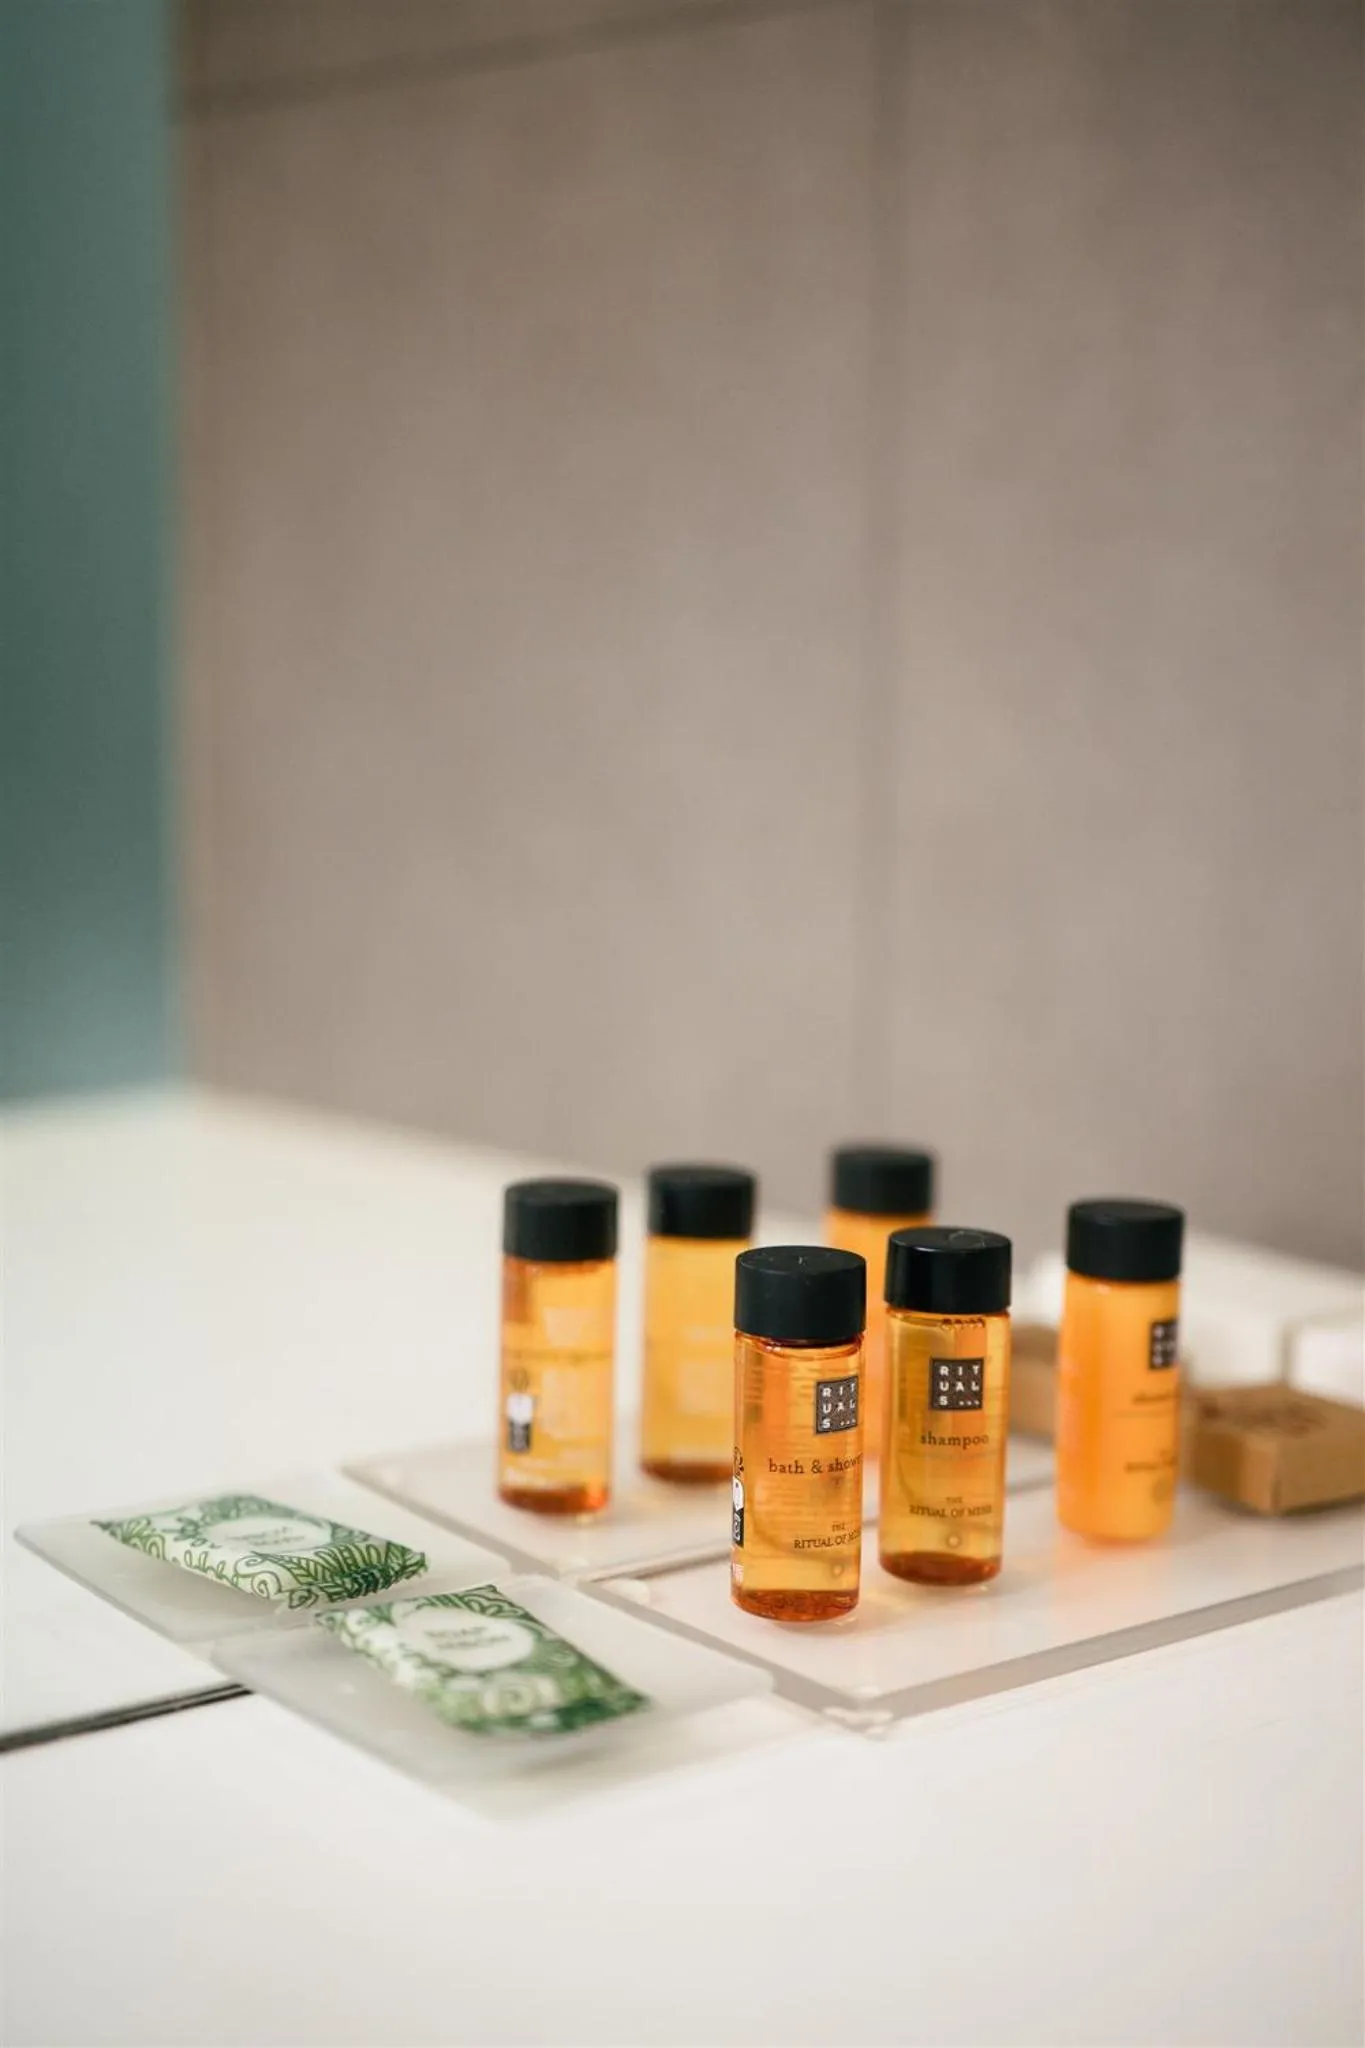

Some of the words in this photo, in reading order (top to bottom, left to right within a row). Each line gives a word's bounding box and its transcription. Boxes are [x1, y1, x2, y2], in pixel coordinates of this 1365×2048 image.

[940, 1365, 980, 1376] RIT
[940, 1381, 980, 1392] UAL
[921, 1430, 989, 1450] shampoo
[768, 1457, 804, 1474] bath
[811, 1459, 822, 1474] &
[794, 1537, 833, 1549] RITUAL
